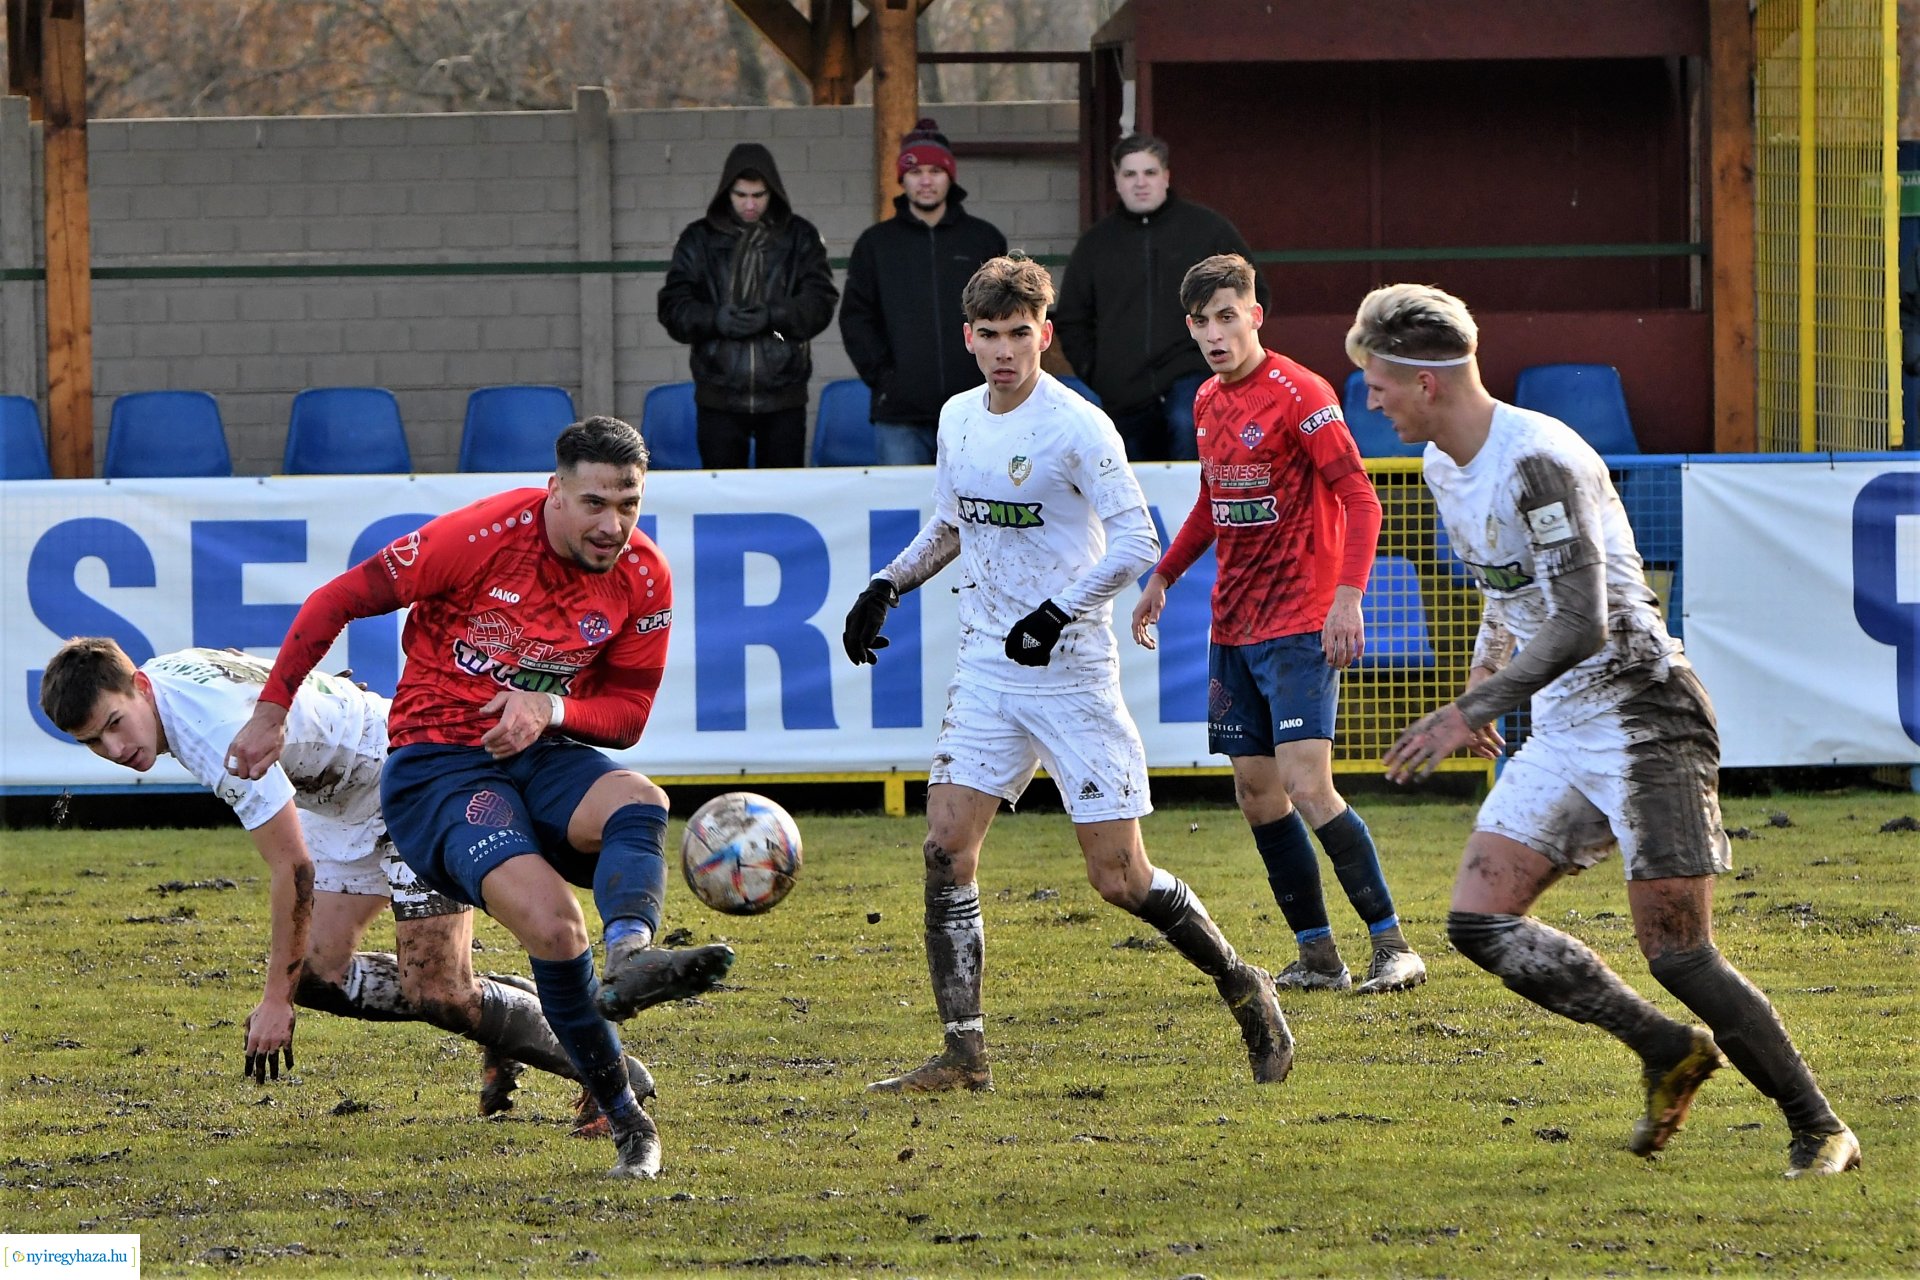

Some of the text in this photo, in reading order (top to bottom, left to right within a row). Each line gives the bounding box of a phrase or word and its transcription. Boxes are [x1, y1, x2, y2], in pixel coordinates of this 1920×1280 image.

[488, 586, 521, 603] JAKO
[1208, 722, 1242, 732] ESTIGE
[1279, 718, 1303, 730] JAKO
[1079, 792, 1104, 801] adidas
